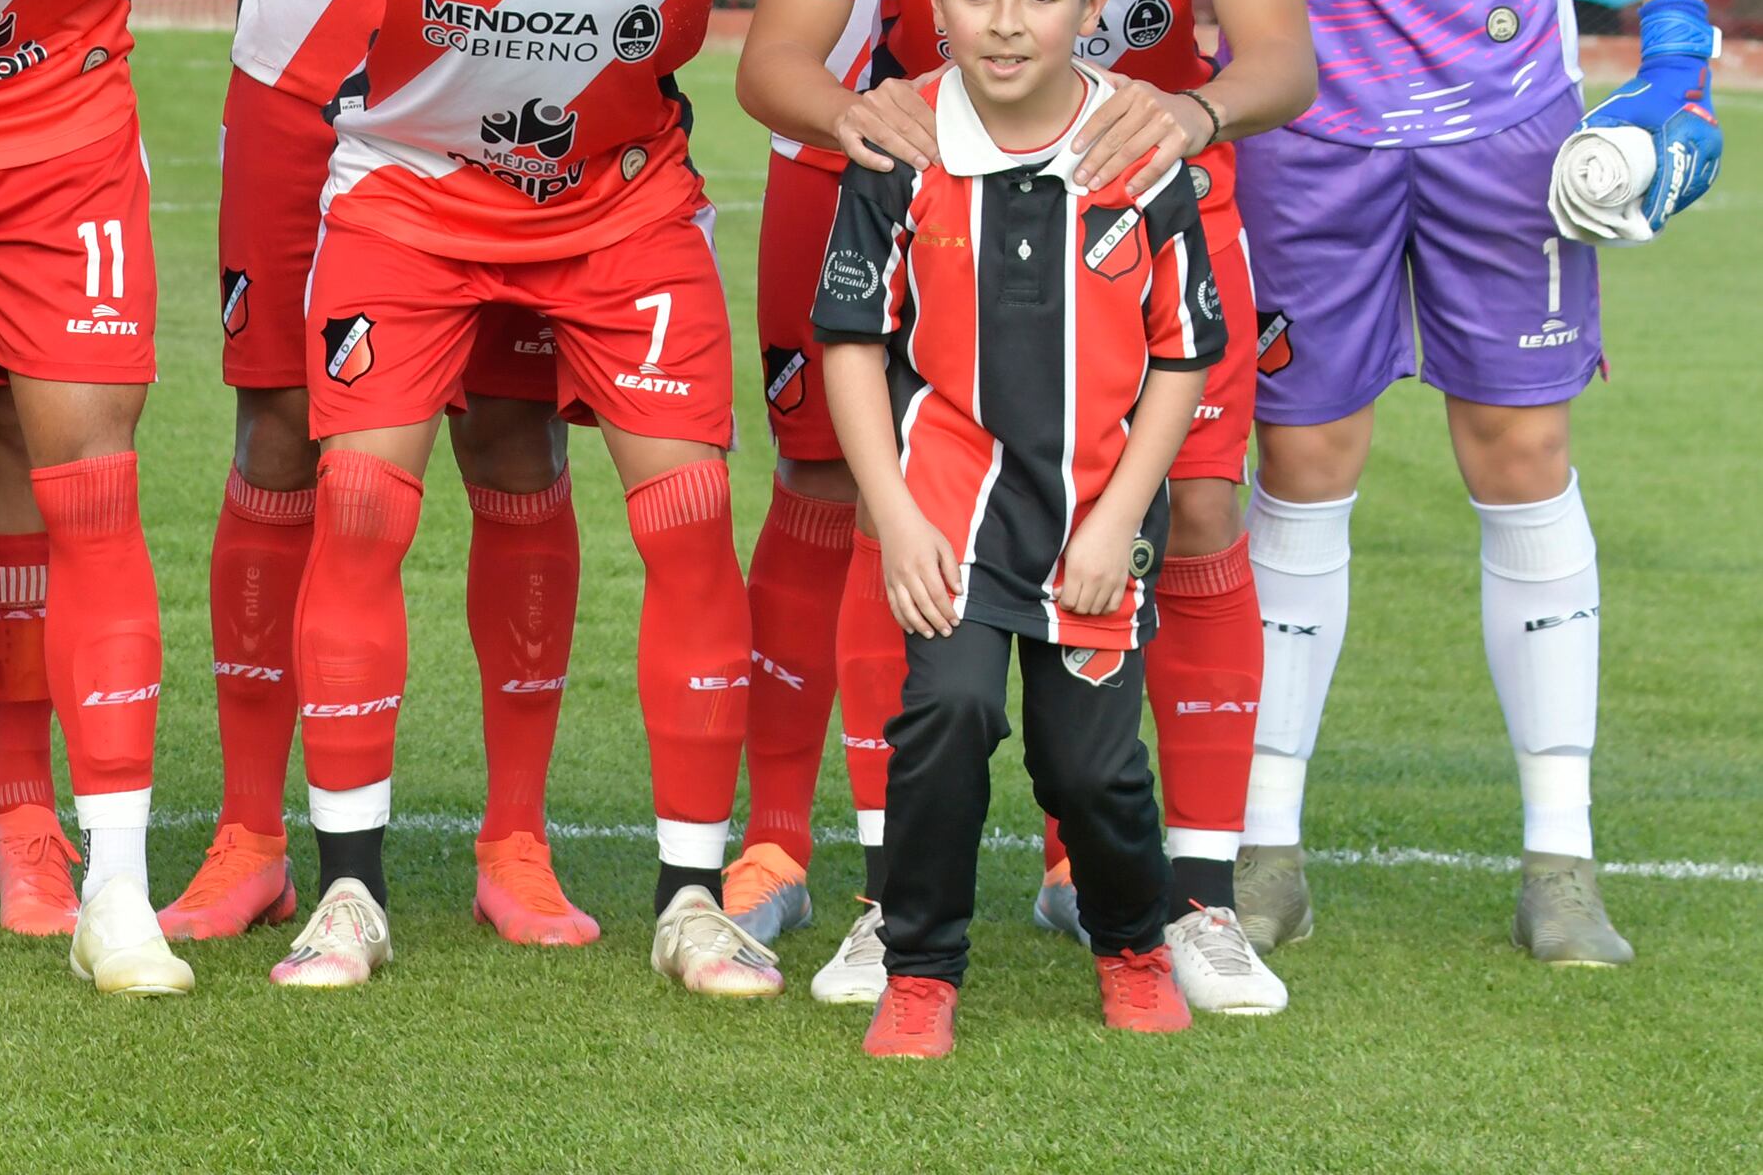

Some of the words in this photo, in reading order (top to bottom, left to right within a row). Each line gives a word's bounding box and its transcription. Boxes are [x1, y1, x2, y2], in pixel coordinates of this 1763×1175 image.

[422, 24, 599, 63] GOBIERNO
[482, 146, 558, 175] MEJOR
[1092, 216, 1131, 259] CDM
[76, 219, 125, 299] 11
[840, 249, 865, 263] 1927
[828, 270, 869, 289] Cruzado
[834, 260, 866, 277] Vamos
[1542, 237, 1562, 312] 1
[830, 288, 858, 301] 2021
[66, 318, 139, 336] LEATIX
[635, 292, 672, 364] 7
[1518, 326, 1580, 349] LEATIX
[332, 324, 360, 367] CDM
[614, 372, 691, 396] LEATIX
[687, 675, 750, 691] LEA
[302, 694, 401, 718] LEATIX
[1177, 700, 1261, 714] LEAT
